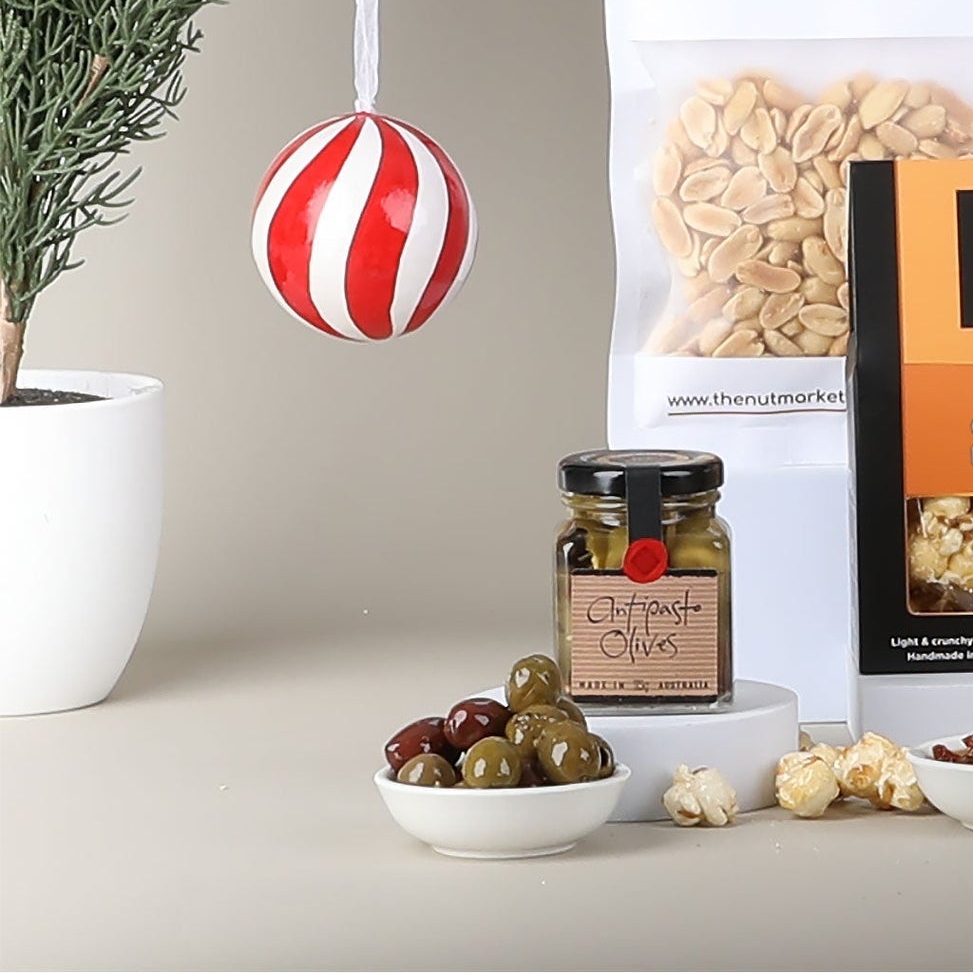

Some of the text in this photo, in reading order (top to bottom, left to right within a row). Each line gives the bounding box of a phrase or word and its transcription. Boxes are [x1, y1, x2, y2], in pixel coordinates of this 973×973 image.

[600, 626, 678, 664] Olives
[890, 636, 919, 649] Light
[920, 636, 929, 646] &
[931, 635, 973, 647] crunchy
[907, 650, 964, 661] Handmade
[659, 680, 709, 690] AUSTRALIA
